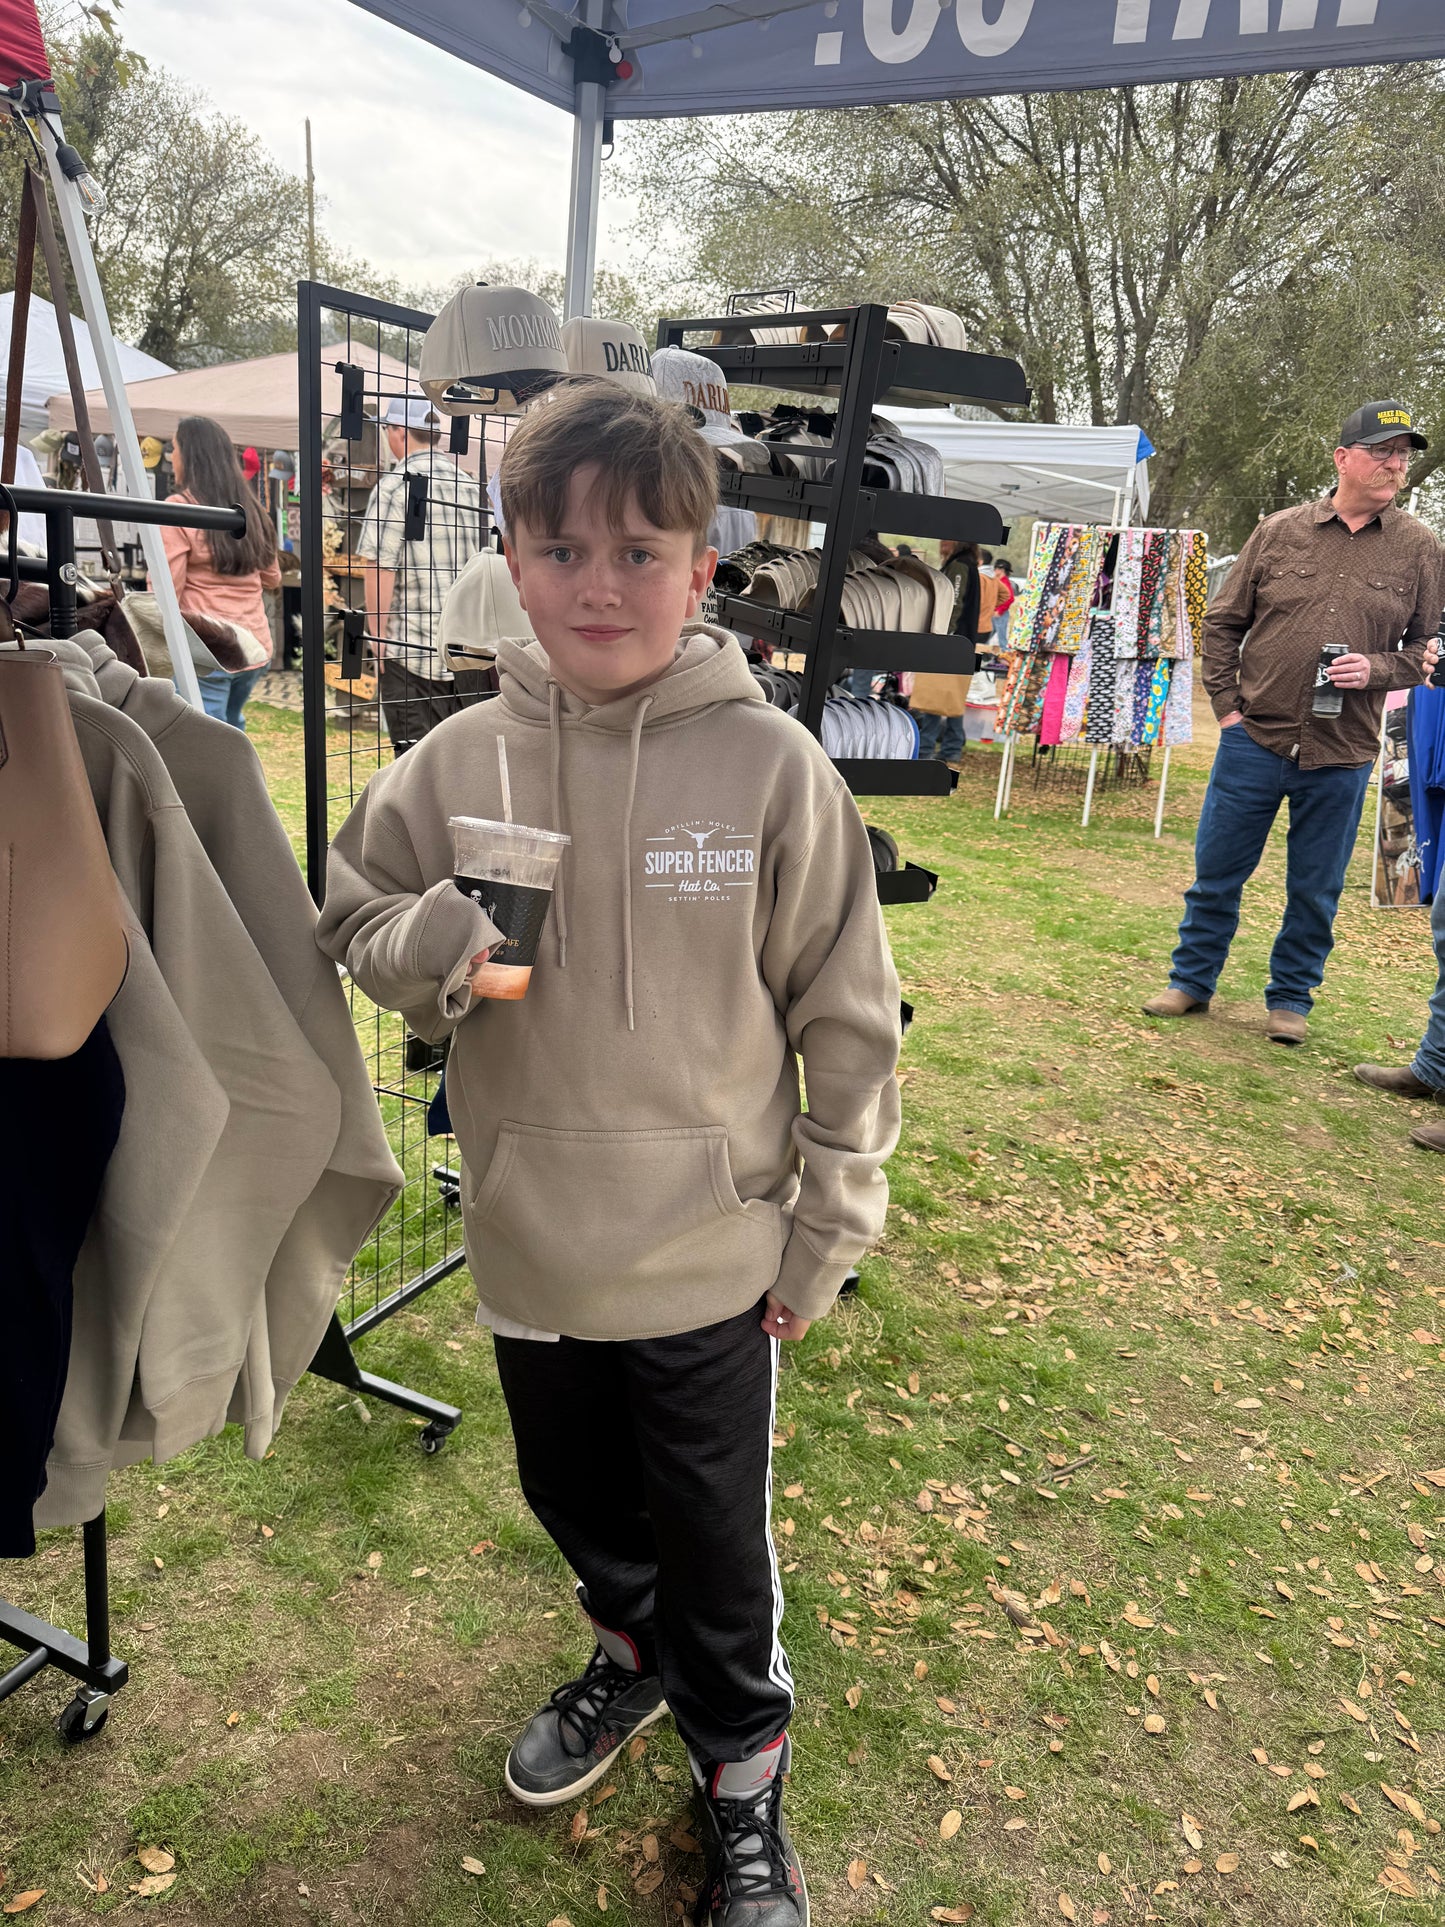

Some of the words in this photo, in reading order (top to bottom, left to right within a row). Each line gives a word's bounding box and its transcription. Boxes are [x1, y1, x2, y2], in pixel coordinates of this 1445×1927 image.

[664, 820, 705, 834] DRILLIN'
[708, 821, 736, 833] HOLES
[644, 850, 694, 875] SUPER
[698, 849, 755, 873] FENCER
[678, 880, 702, 892] Hat
[703, 879, 721, 892] Co.
[503, 938, 520, 947] AFE
